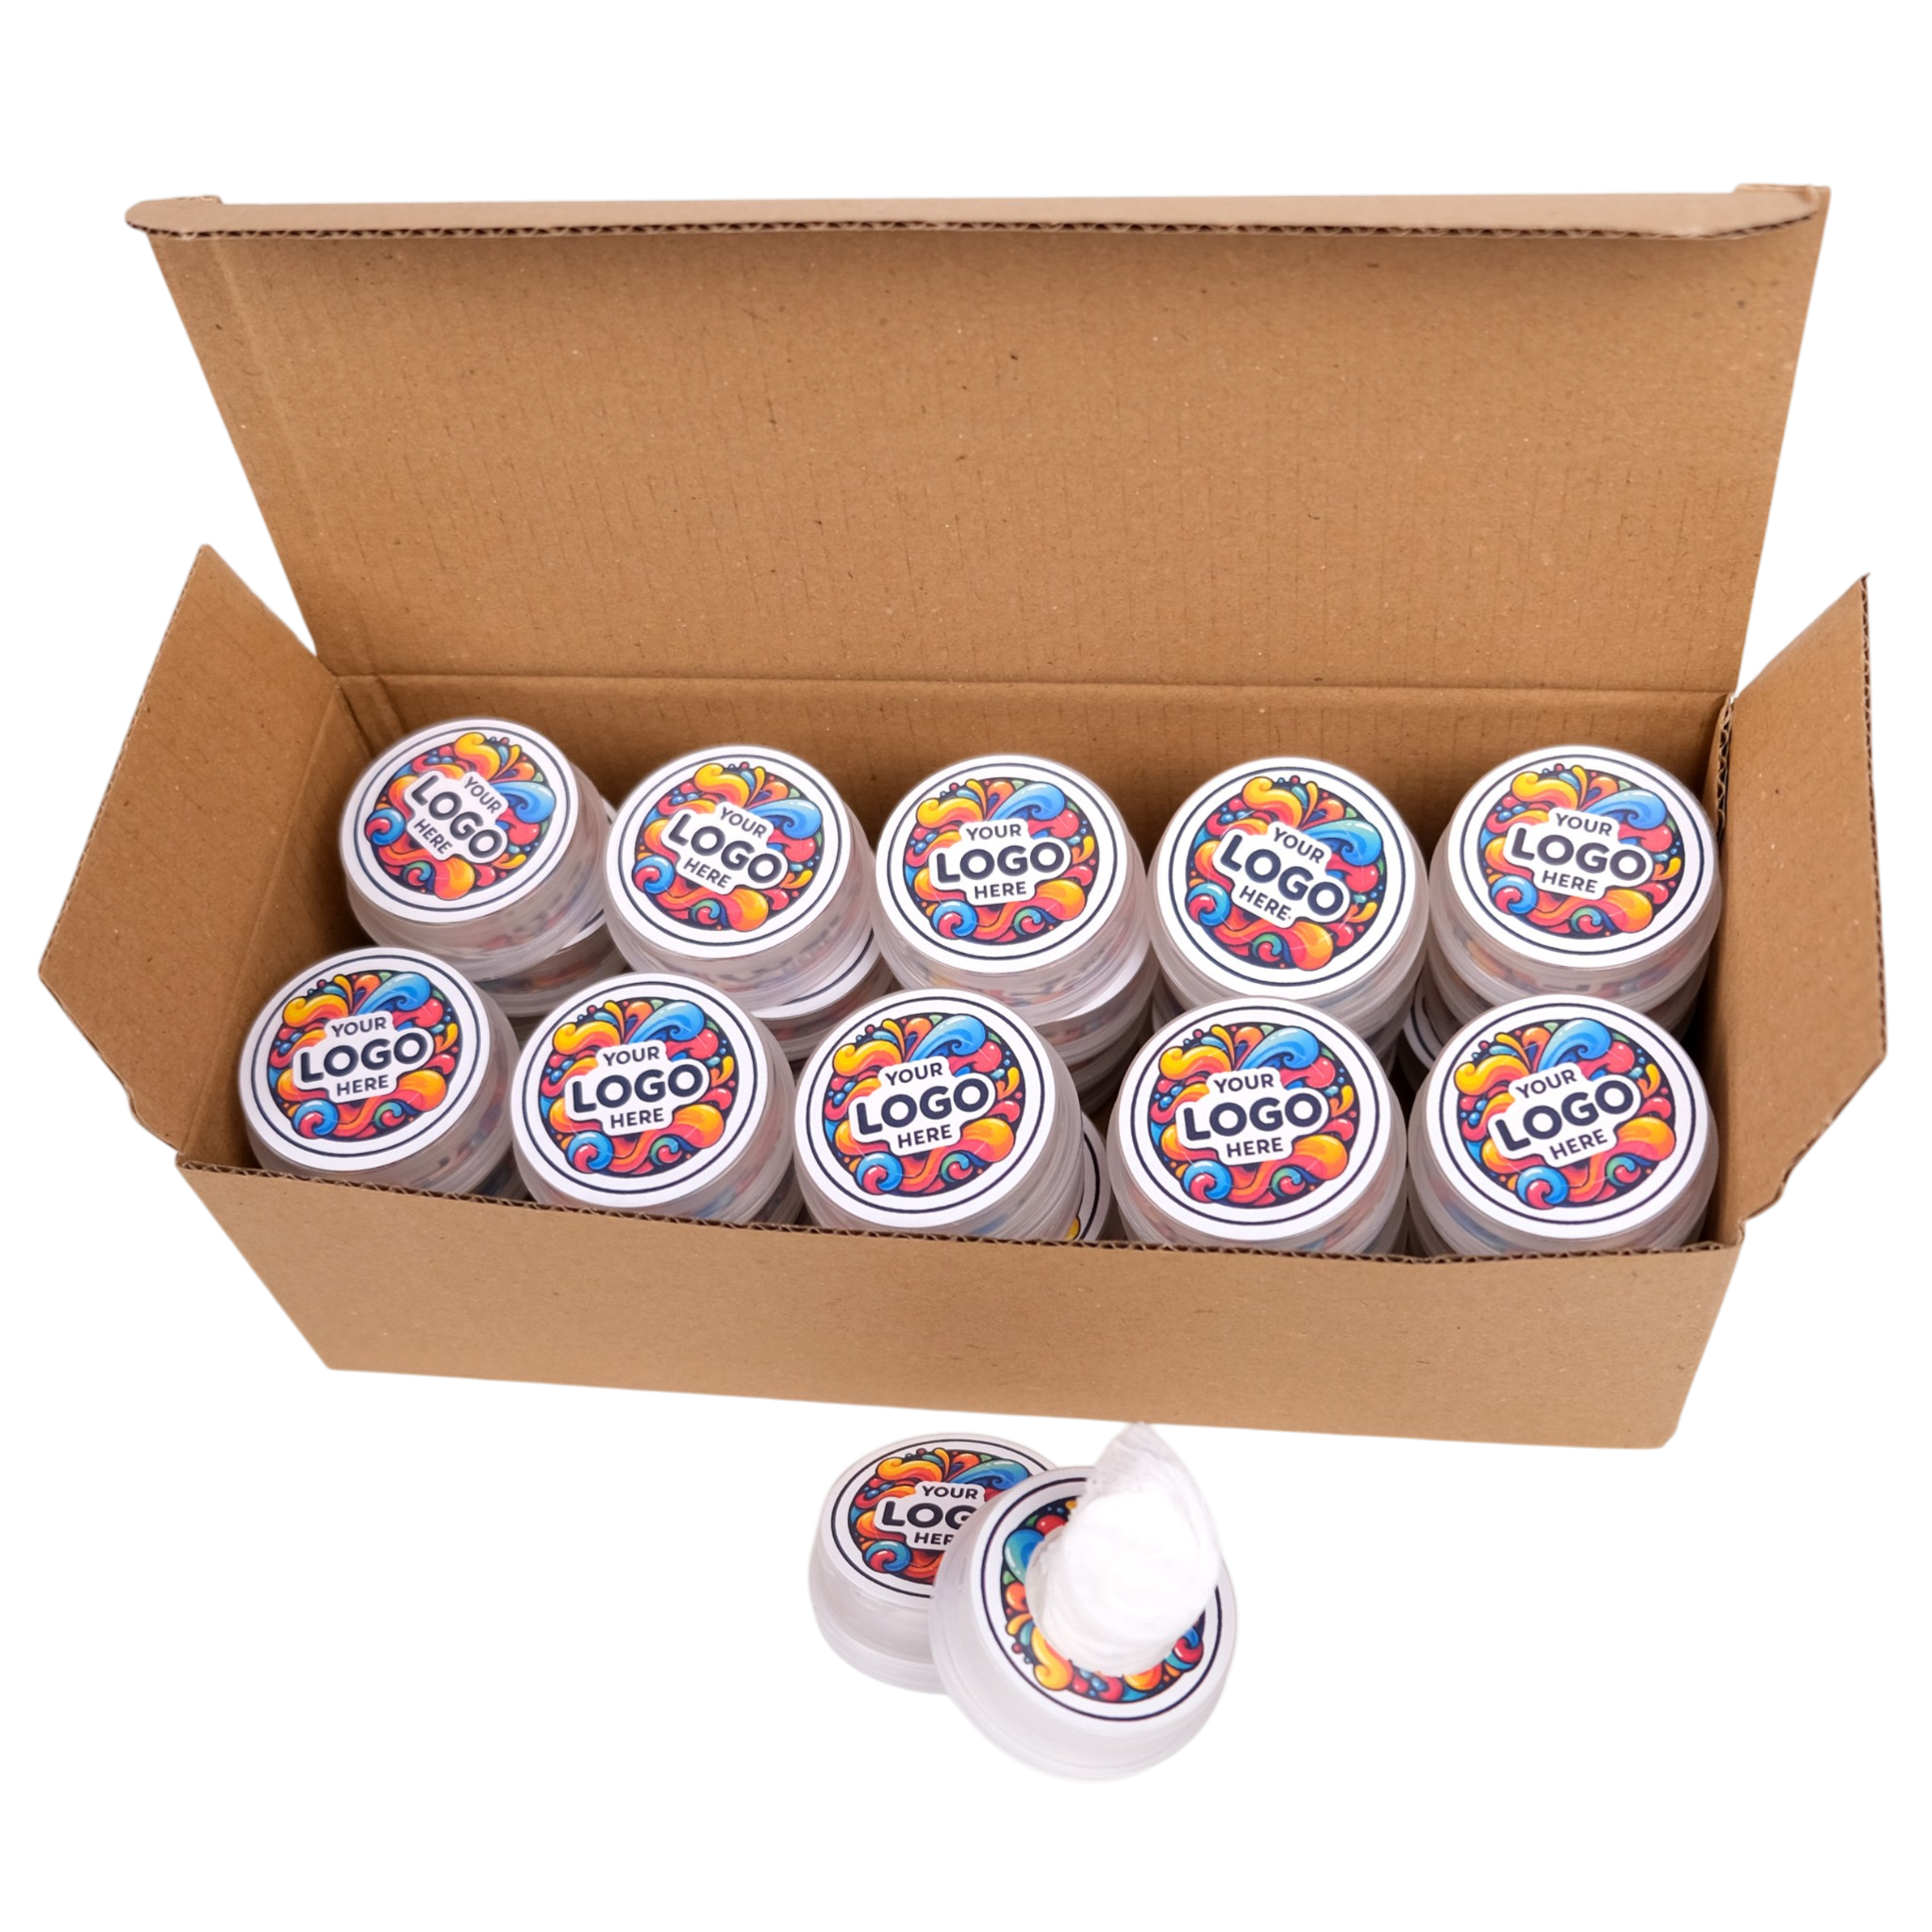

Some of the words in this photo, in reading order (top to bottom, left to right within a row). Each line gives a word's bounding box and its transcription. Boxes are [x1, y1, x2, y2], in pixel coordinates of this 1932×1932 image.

[463, 776, 502, 814] YOUR
[410, 774, 503, 858] LOGO
[720, 807, 768, 839] YOUR
[1556, 812, 1612, 836] YOUR
[413, 818, 453, 855] HERE
[966, 824, 1022, 841] YOUR
[1274, 826, 1324, 864] YOUR
[668, 813, 782, 884] LOGO
[936, 841, 1064, 883] LOGO
[1511, 827, 1646, 881] LOGO
[683, 858, 732, 889] HERE
[1220, 834, 1344, 916] LOGO
[1541, 870, 1598, 893] HERE
[974, 881, 1026, 899] HERE
[331, 1016, 386, 1038] YOUR
[300, 1032, 427, 1083] LOGO
[603, 1046, 659, 1066] YOUR
[337, 1074, 388, 1096] HERE
[572, 1063, 703, 1113] LOGO
[885, 1062, 942, 1086] YOUR
[1213, 1074, 1274, 1093] YOUR
[1516, 1069, 1577, 1099] YOUR
[610, 1108, 663, 1129] HERE
[856, 1078, 990, 1136] LOGO
[1183, 1092, 1322, 1141] LOGO
[1495, 1080, 1634, 1152] LOGO
[897, 1124, 952, 1149] HERE
[1226, 1137, 1283, 1158] HERE
[1549, 1128, 1607, 1159] HERE
[922, 1485, 978, 1499] YOUR
[882, 1500, 977, 1530] LOG
[914, 1532, 955, 1545] HER
